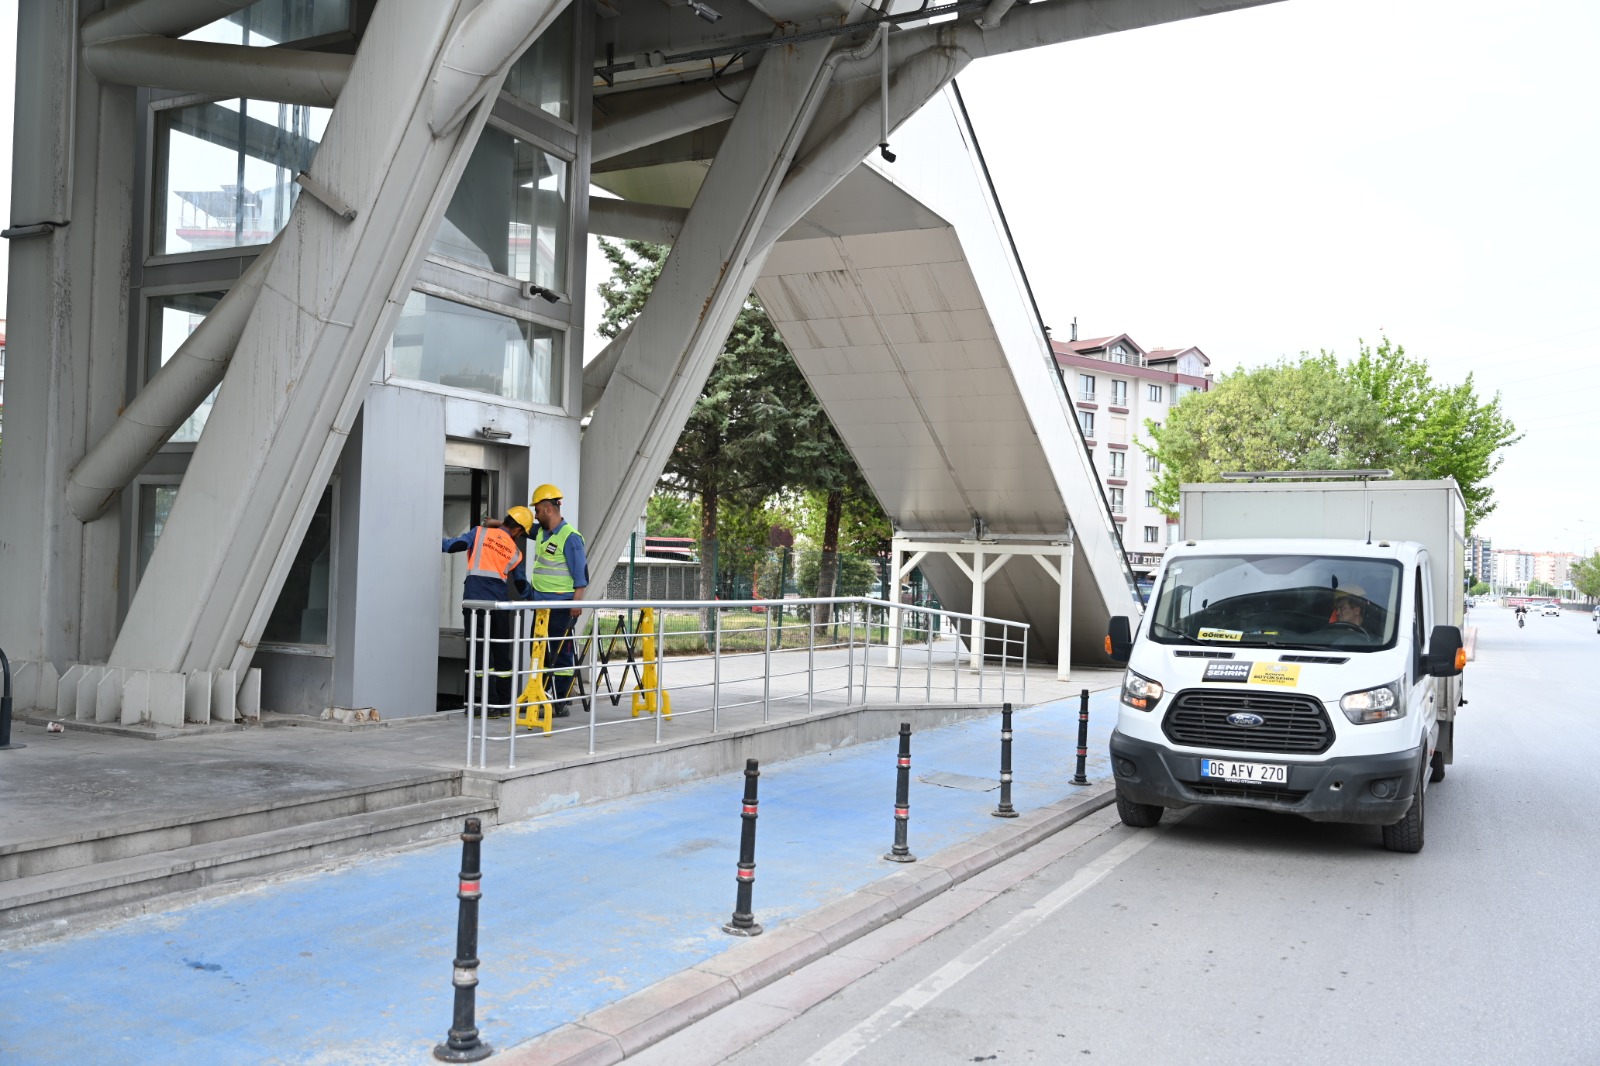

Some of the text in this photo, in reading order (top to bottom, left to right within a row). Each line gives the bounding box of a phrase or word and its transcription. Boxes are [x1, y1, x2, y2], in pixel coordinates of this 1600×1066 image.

[1233, 714, 1255, 725] Ford
[1210, 762, 1225, 776] 06
[1230, 763, 1254, 778] AFV
[1261, 766, 1284, 781] 270
